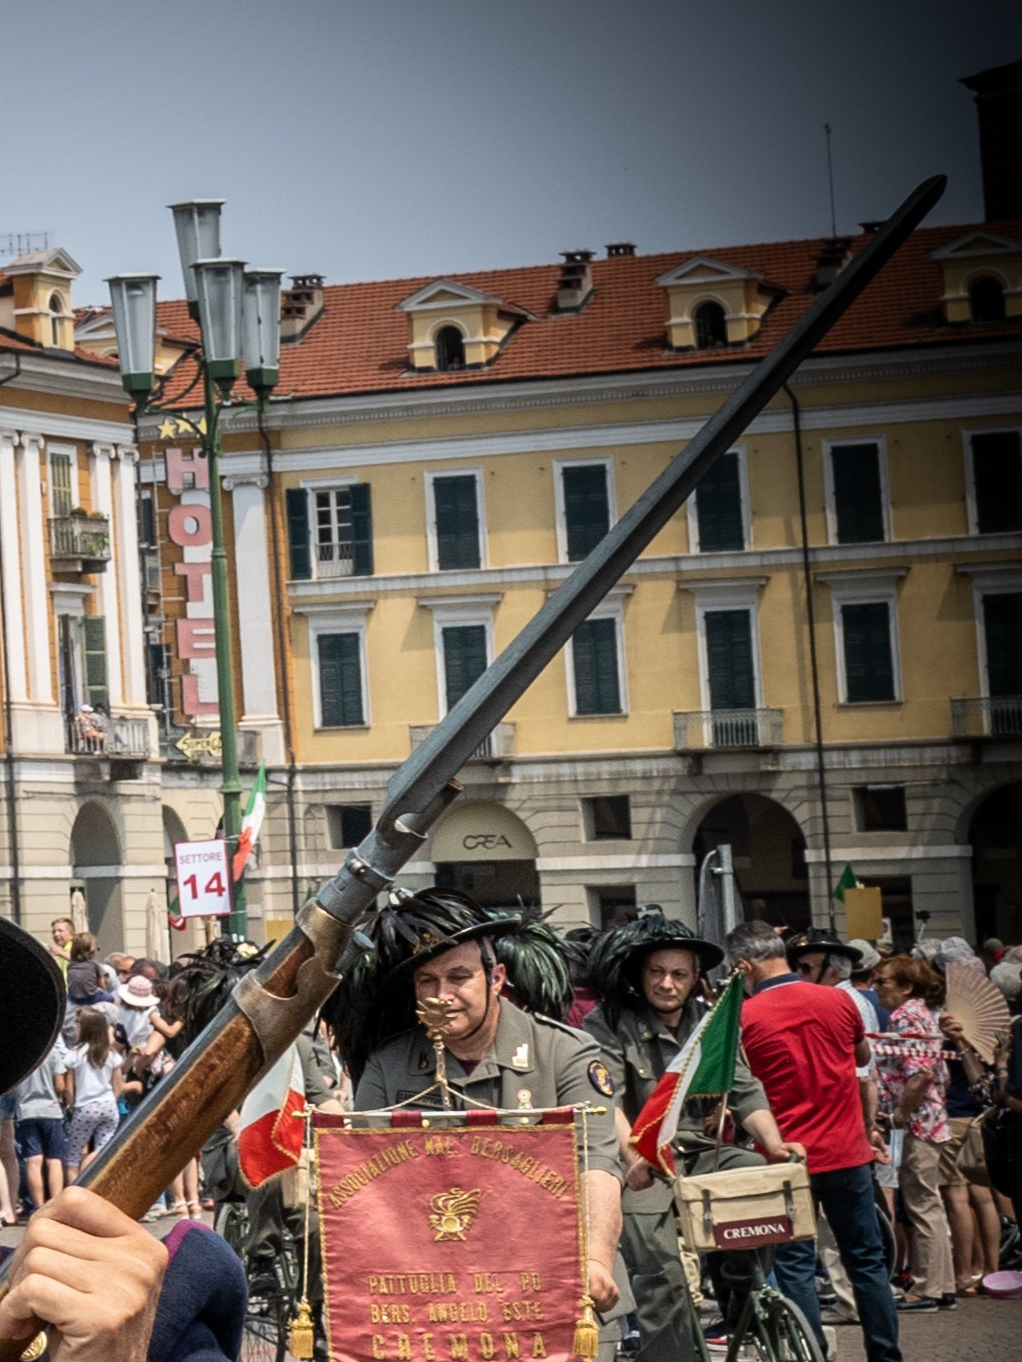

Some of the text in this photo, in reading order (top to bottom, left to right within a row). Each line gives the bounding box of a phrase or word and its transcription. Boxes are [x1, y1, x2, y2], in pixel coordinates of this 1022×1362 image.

[166, 448, 221, 715] HOTEL
[179, 852, 222, 864] SETTORE
[183, 871, 226, 900] 14
[329, 1139, 419, 1209] ASSOCIAZIONE
[470, 1135, 571, 1199] BERSAGLIERI
[723, 1223, 786, 1240] CREMONA
[369, 1272, 542, 1295] PATTUGLIA DEL PO
[428, 1303, 488, 1323] ANGELO
[371, 1332, 547, 1361] CREMONA
